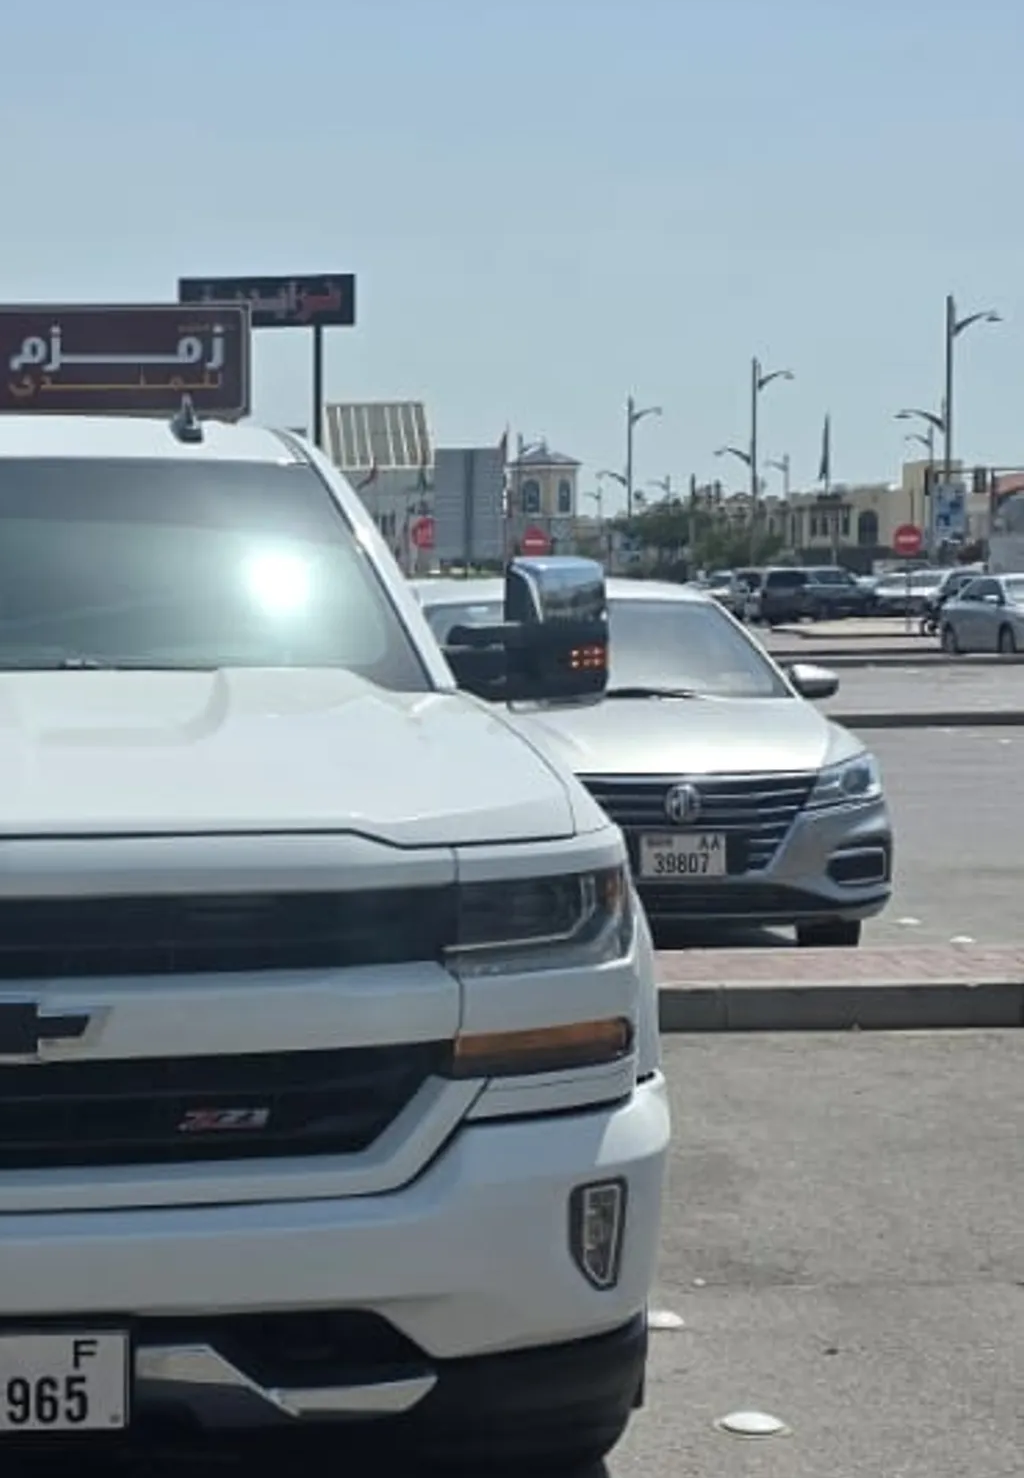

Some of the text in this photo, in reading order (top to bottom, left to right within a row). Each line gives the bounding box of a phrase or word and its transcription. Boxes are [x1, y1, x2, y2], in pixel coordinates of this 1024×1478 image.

[10, 324, 223, 371] زمزم
[699, 835, 721, 851] AA
[653, 852, 709, 874] 39807
[73, 1340, 98, 1369] F
